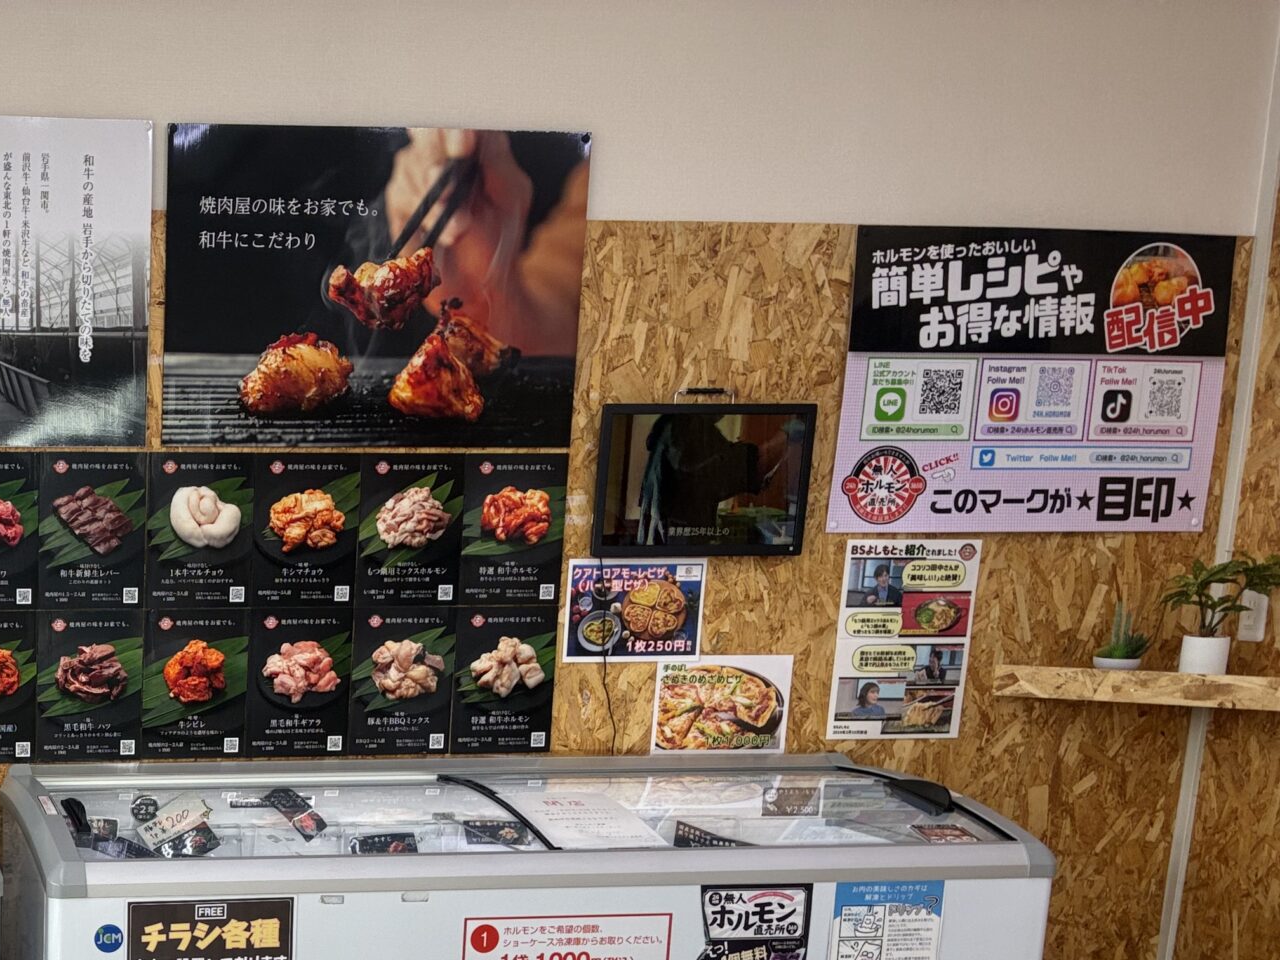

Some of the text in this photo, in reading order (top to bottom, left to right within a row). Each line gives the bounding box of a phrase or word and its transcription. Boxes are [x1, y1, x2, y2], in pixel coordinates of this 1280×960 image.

[40, 152, 50, 214] 岩手県一関市。
[199, 195, 379, 218] 焼肉屋の味をお家でも。
[198, 230, 316, 251] 和牛にこだわり
[79, 153, 95, 361] 和牛の産地 岩手から切りたての味を
[872, 239, 1037, 264] ホルモンを使ったおいしい
[872, 250, 1084, 310] 簡単レシピや
[919, 293, 1095, 348] お得な情報
[1105, 287, 1214, 352] 配信中
[988, 365, 1027, 373] Instagram
[1102, 366, 1127, 374] TikTok
[922, 452, 960, 472] CLICK!!
[1006, 454, 1034, 463] Twitter
[860, 479, 907, 493] ホルモン
[573, 567, 668, 579] クアトロアモーレピザ
[626, 640, 686, 653] 1枚250円
[661, 674, 743, 684] さぬきのめざめピザ
[723, 893, 747, 904] 無人
[198, 907, 224, 917] FREE
[709, 902, 796, 931] ホルモン
[97, 928, 121, 944] JCM
[141, 918, 281, 953] チラシ各種
[504, 924, 603, 935] ホルモンをご希望の個数、
[753, 924, 786, 936] 直売所
[480, 932, 488, 947] 1
[503, 935, 663, 948] ショーケース冷凍庫からお取りください。
